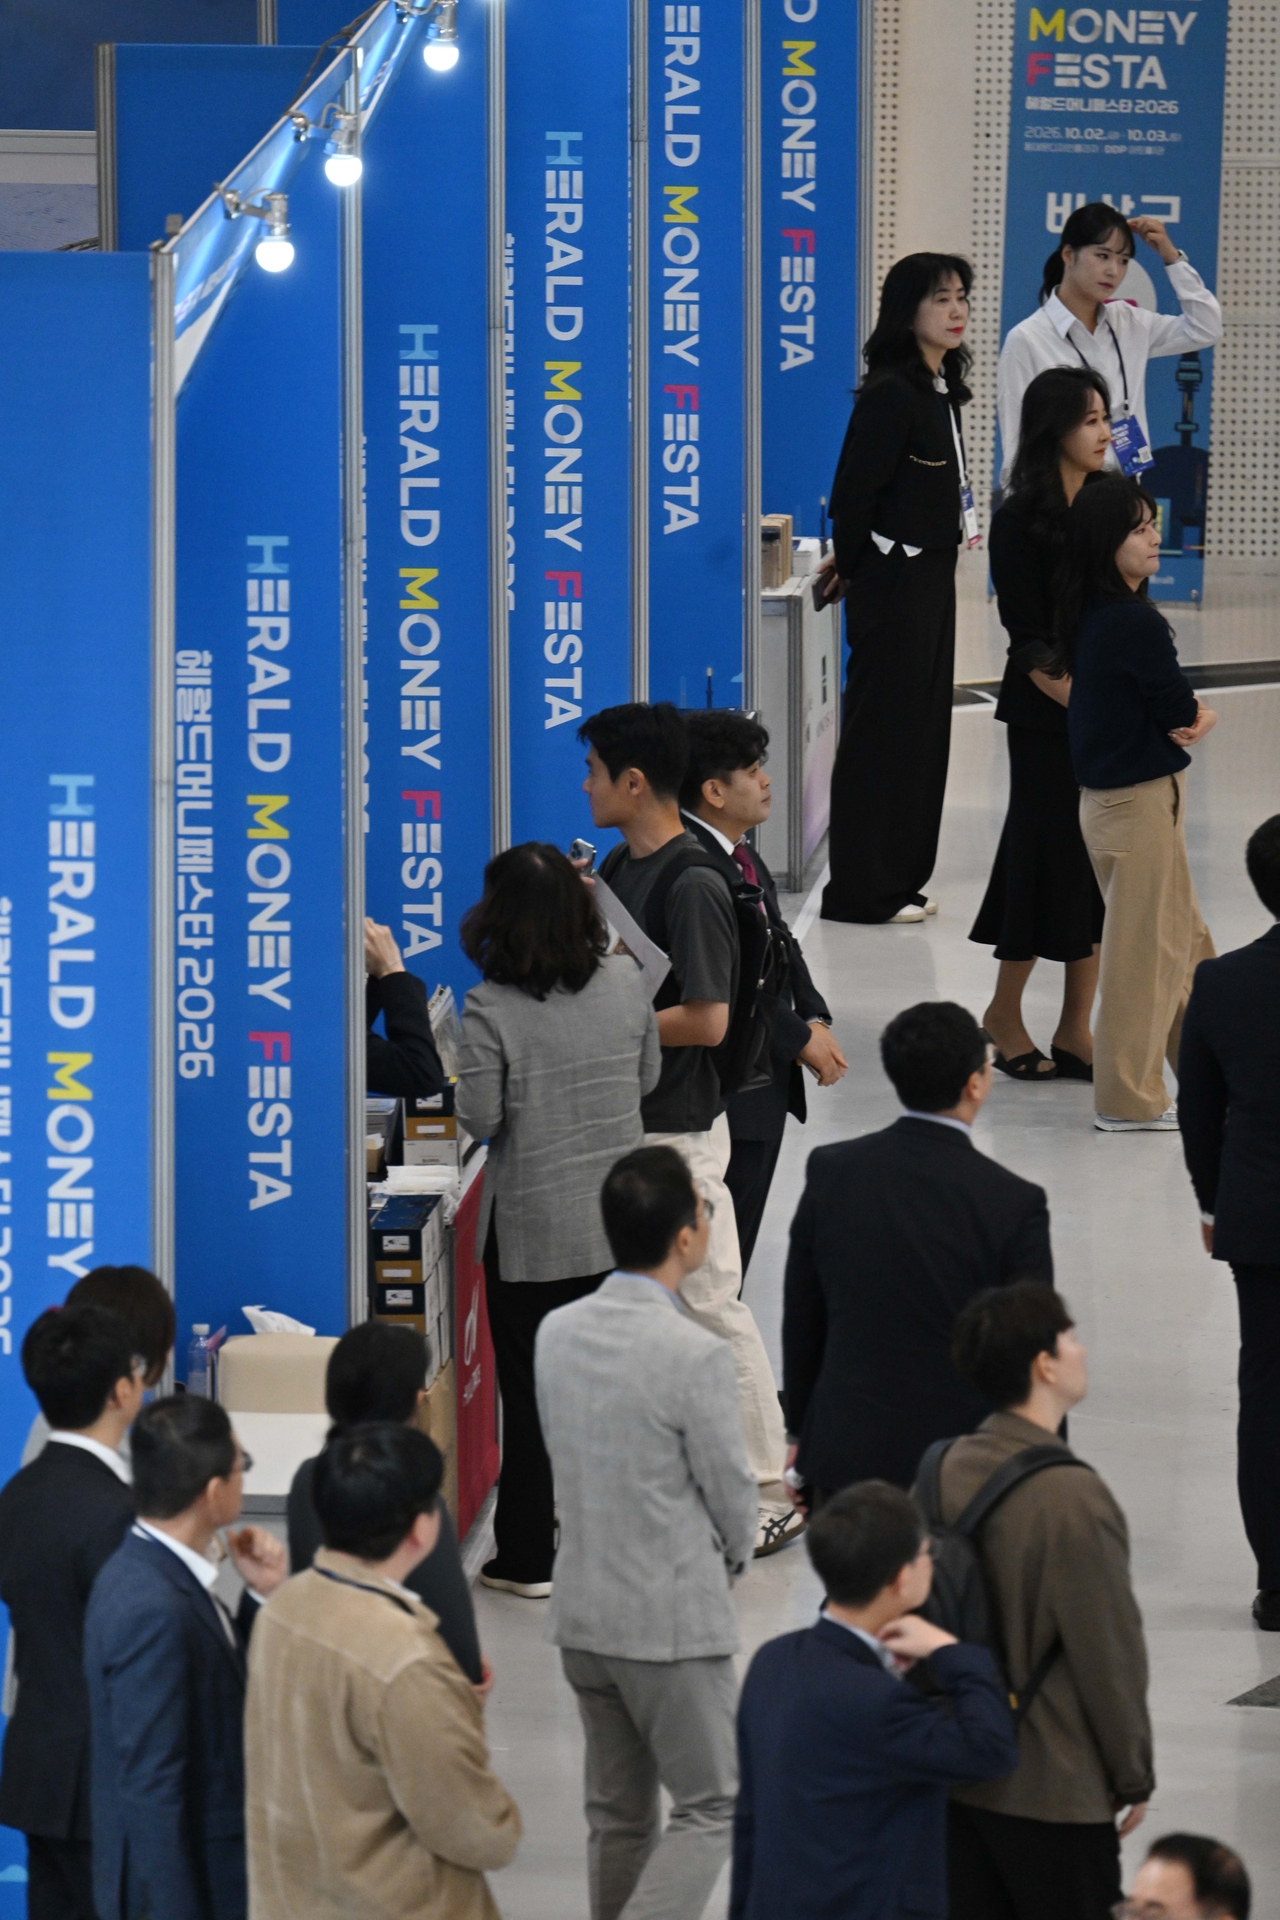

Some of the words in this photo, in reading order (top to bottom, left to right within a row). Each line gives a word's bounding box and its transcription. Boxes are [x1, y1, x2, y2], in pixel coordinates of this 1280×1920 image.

[1026, 52, 1168, 90] FESTA
[1029, 7, 1198, 45] MONEY
[1134, 100, 1180, 114] 2026
[782, 41, 817, 211] MONEY
[546, 132, 583, 341] HERALD
[663, 186, 699, 366] MONEY
[780, 229, 816, 371] FESTA
[400, 325, 440, 546] HERALD
[544, 361, 583, 551] MONEY
[663, 385, 699, 534] FESTA
[247, 537, 290, 772] HERALD
[399, 568, 441, 770] MONEY
[543, 571, 583, 730] FESTA
[176, 650, 214, 950] 헤럴드머니페스타
[401, 790, 442, 959] FESTA
[48, 776, 95, 1028] HERALD
[247, 794, 291, 1010] MONEY
[178, 957, 215, 1079] 2026
[47, 1052, 94, 1279] MONEY
[248, 1031, 292, 1210] FESTA
